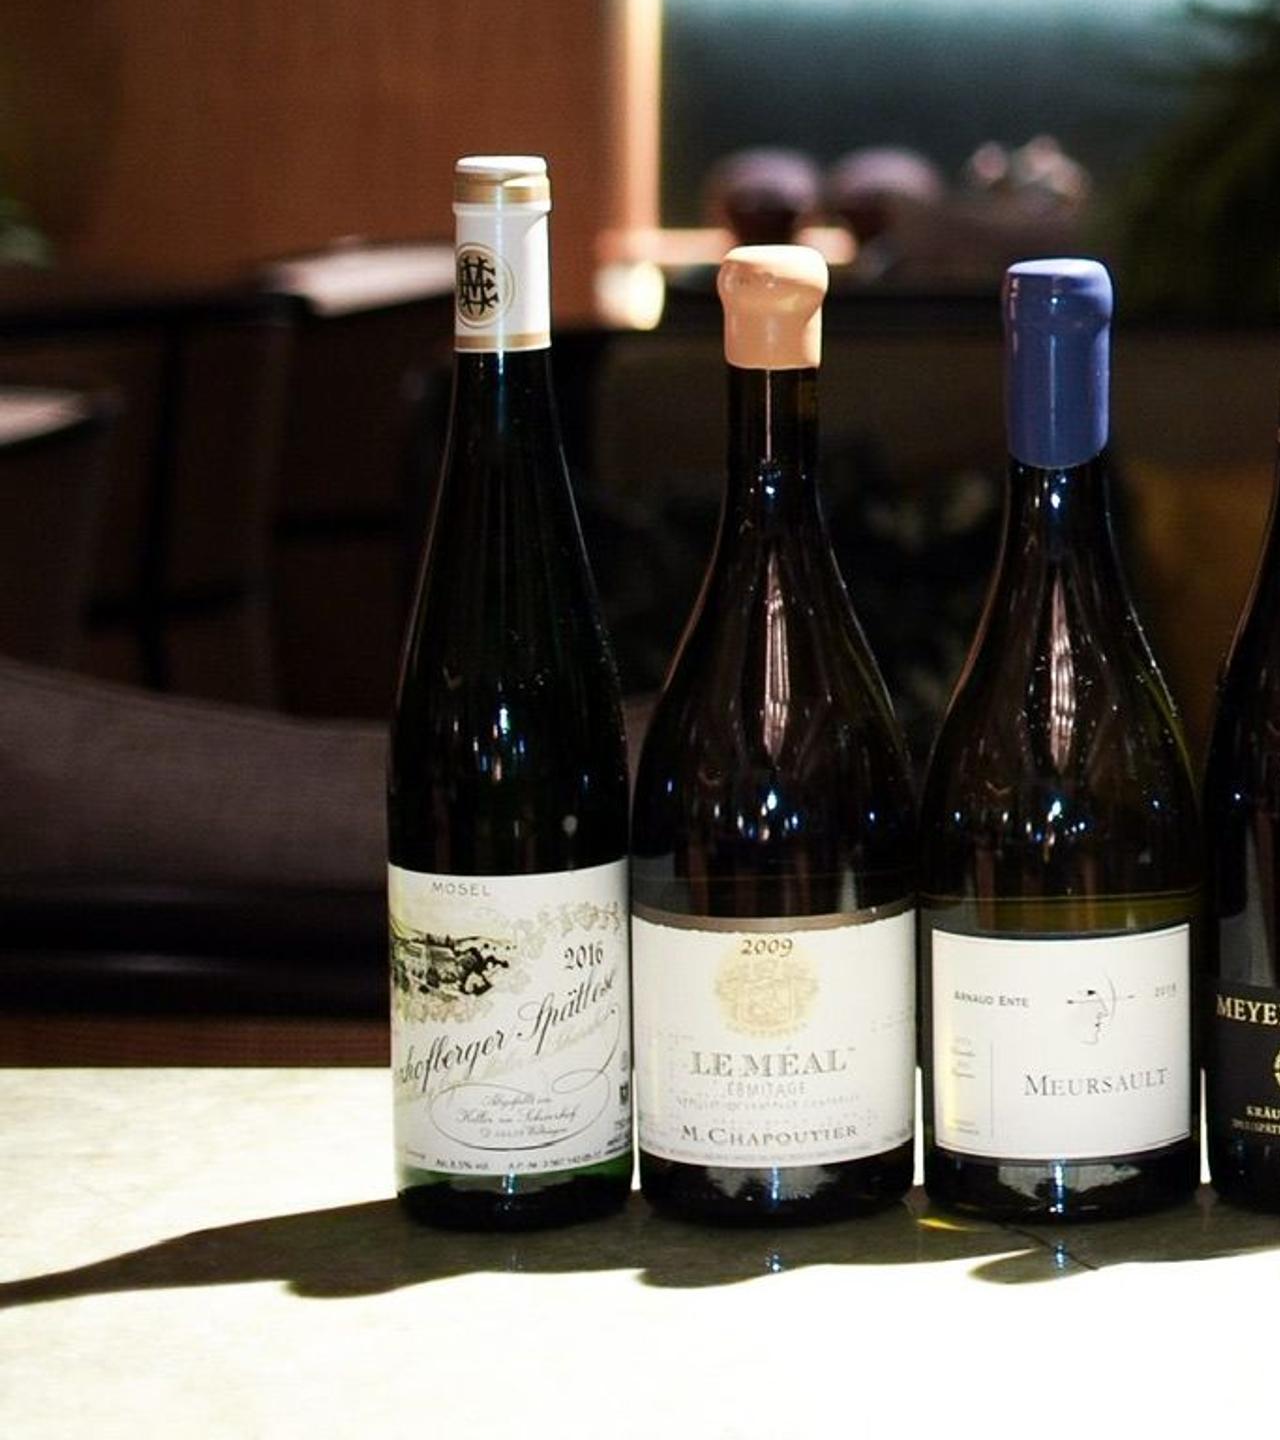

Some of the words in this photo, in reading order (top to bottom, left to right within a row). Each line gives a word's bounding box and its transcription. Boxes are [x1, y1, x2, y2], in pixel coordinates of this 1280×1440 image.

[432, 881, 492, 897] MOSEL
[563, 939, 605, 970] 2016
[739, 938, 794, 958] 2009
[999, 995, 1030, 1008] ENTE
[690, 1051, 733, 1077] LE
[1024, 1068, 1169, 1097] MEURSAULT
[708, 1125, 858, 1147] CHAPOUTIER
